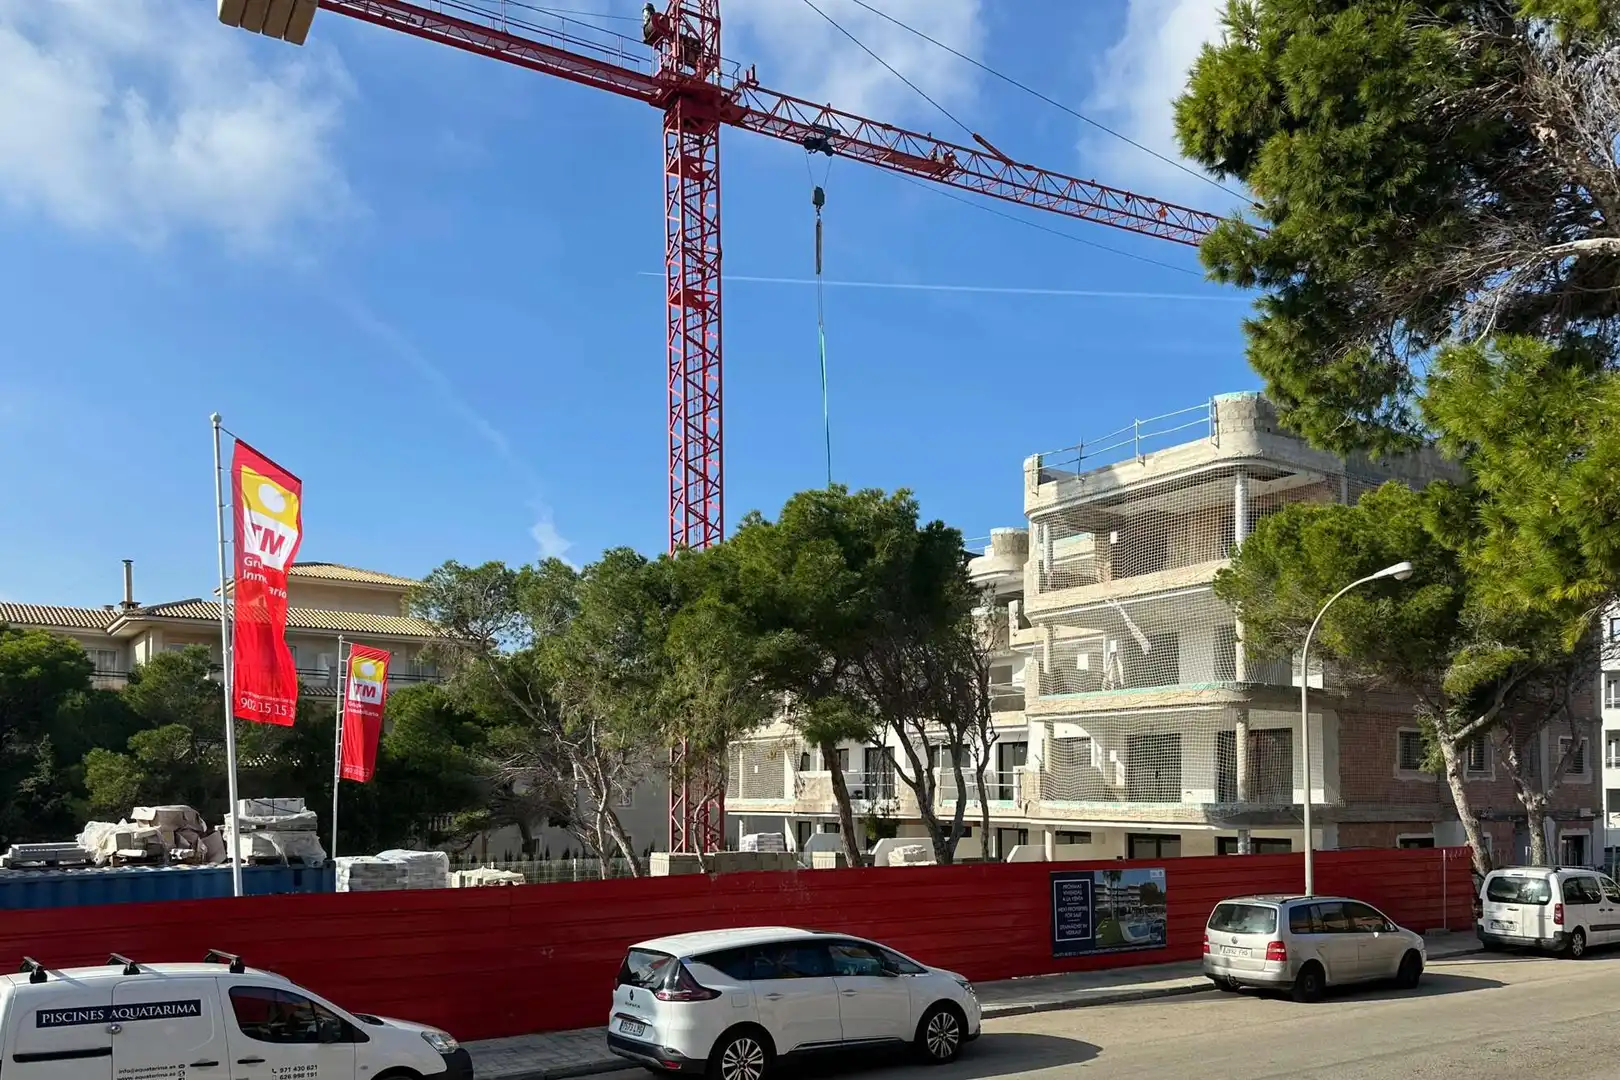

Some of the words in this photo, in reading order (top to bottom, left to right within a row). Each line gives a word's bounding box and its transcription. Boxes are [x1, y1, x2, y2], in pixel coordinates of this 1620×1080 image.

[258, 701, 272, 714] 15
[274, 703, 287, 716] 15
[42, 1009, 104, 1024] PISCINES
[110, 1003, 197, 1020] AQUATARIMA
